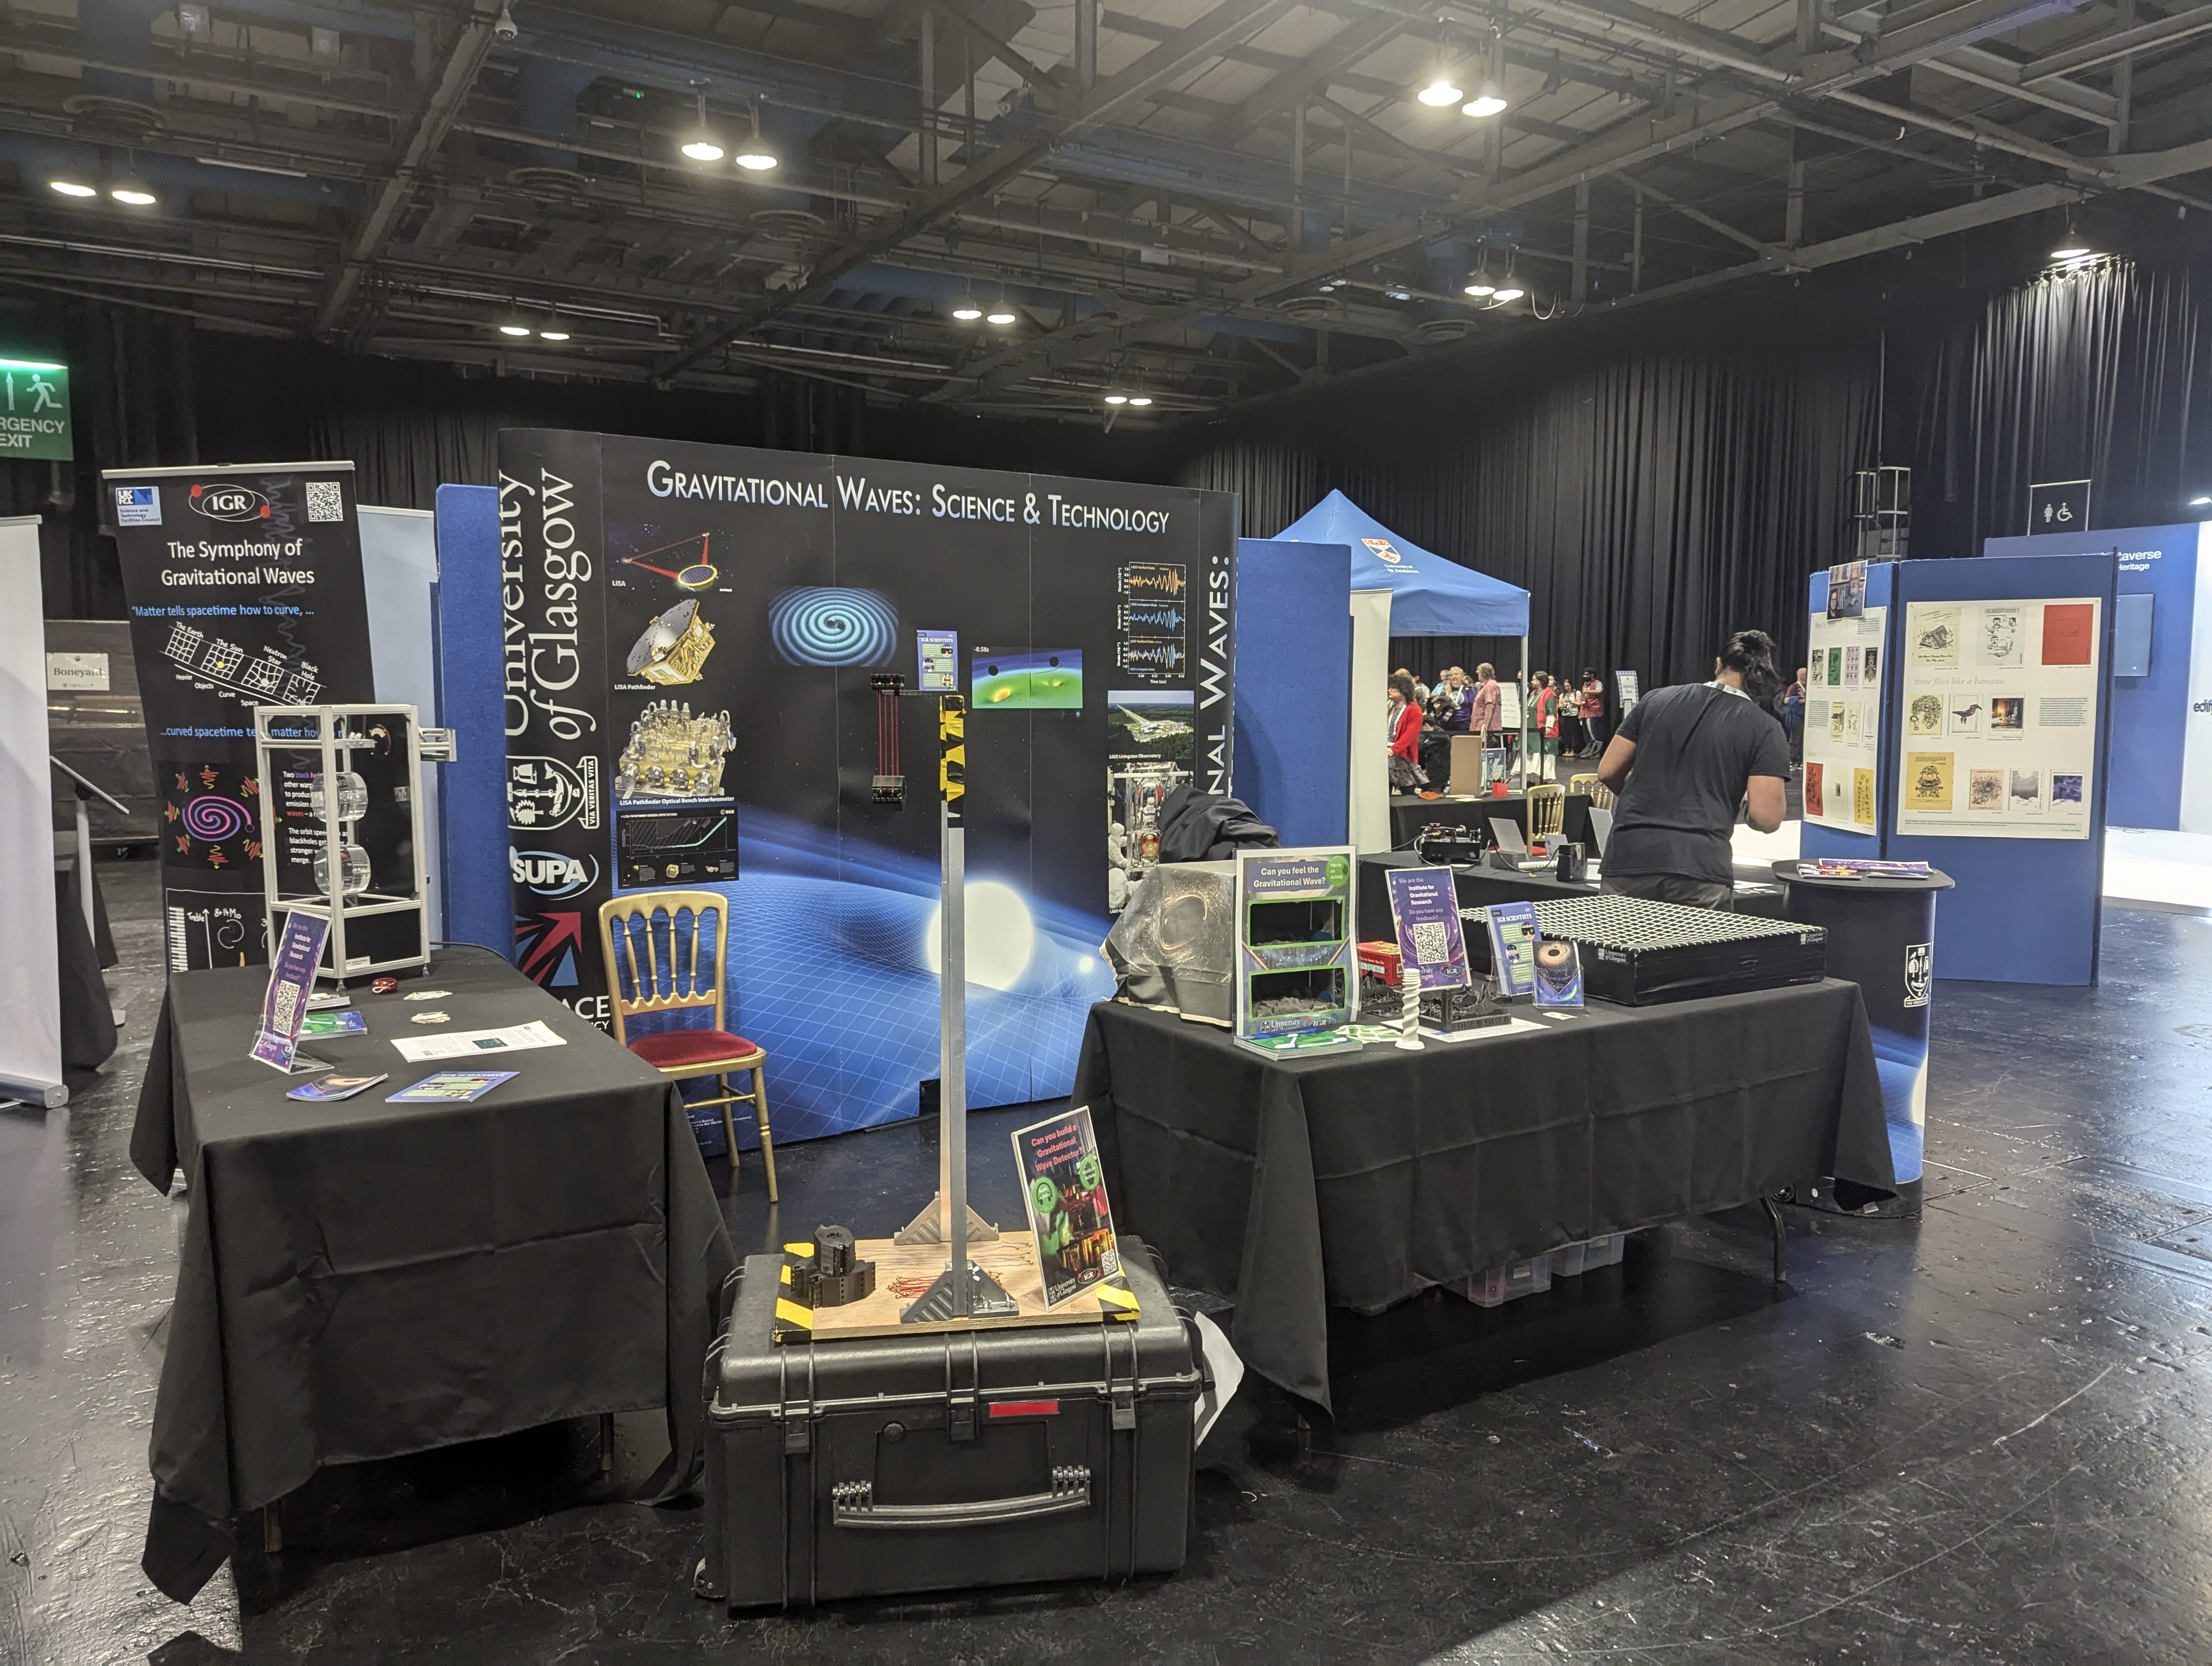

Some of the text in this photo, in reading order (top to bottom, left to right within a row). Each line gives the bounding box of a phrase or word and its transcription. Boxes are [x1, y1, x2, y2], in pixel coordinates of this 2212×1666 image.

[0, 434, 33, 448] EXIT
[211, 495, 247, 511] IGR
[647, 460, 1169, 533] GRAVITATIONAL WAVES: SCIENCE & TECHNOLOGY
[167, 537, 303, 561] The Symphony of
[161, 567, 316, 586] Gravitational Waves
[498, 469, 536, 736] University
[528, 467, 596, 740] of Glasgow
[168, 605, 185, 616] tells
[187, 604, 237, 618] spacetime
[240, 604, 261, 615] how
[263, 605, 273, 614] to
[274, 605, 303, 617] curve,
[176, 621, 204, 638] The Earth
[1199, 555, 1230, 710] WAVES:
[216, 638, 243, 653] The Sun
[263, 645, 288, 660] Neutron
[268, 656, 282, 665] Star
[301, 661, 319, 674] Black
[54, 668, 102, 678] Boneyard
[301, 670, 315, 681] Hole
[160, 727, 192, 736] ...curved
[195, 727, 243, 738] spacetime
[271, 727, 302, 737] matter
[512, 858, 588, 884] SUPA
[1261, 866, 1319, 877] Can you feel the
[1253, 877, 1326, 888] Gravitational Wave?
[1506, 913, 1533, 922] SCIENTISTS
[1271, 1018, 1301, 1028] University
[1485, 1017, 1503, 1027] TIME
[1031, 1138, 1045, 1147] Can
[1045, 1132, 1057, 1144] you
[1057, 1124, 1072, 1137] build
[1037, 1136, 1077, 1158] Gravitational
[1035, 1147, 1083, 1172] Wave Detector?
[1084, 1271, 1094, 1281] IGR
[1054, 1277, 1076, 1292] University
